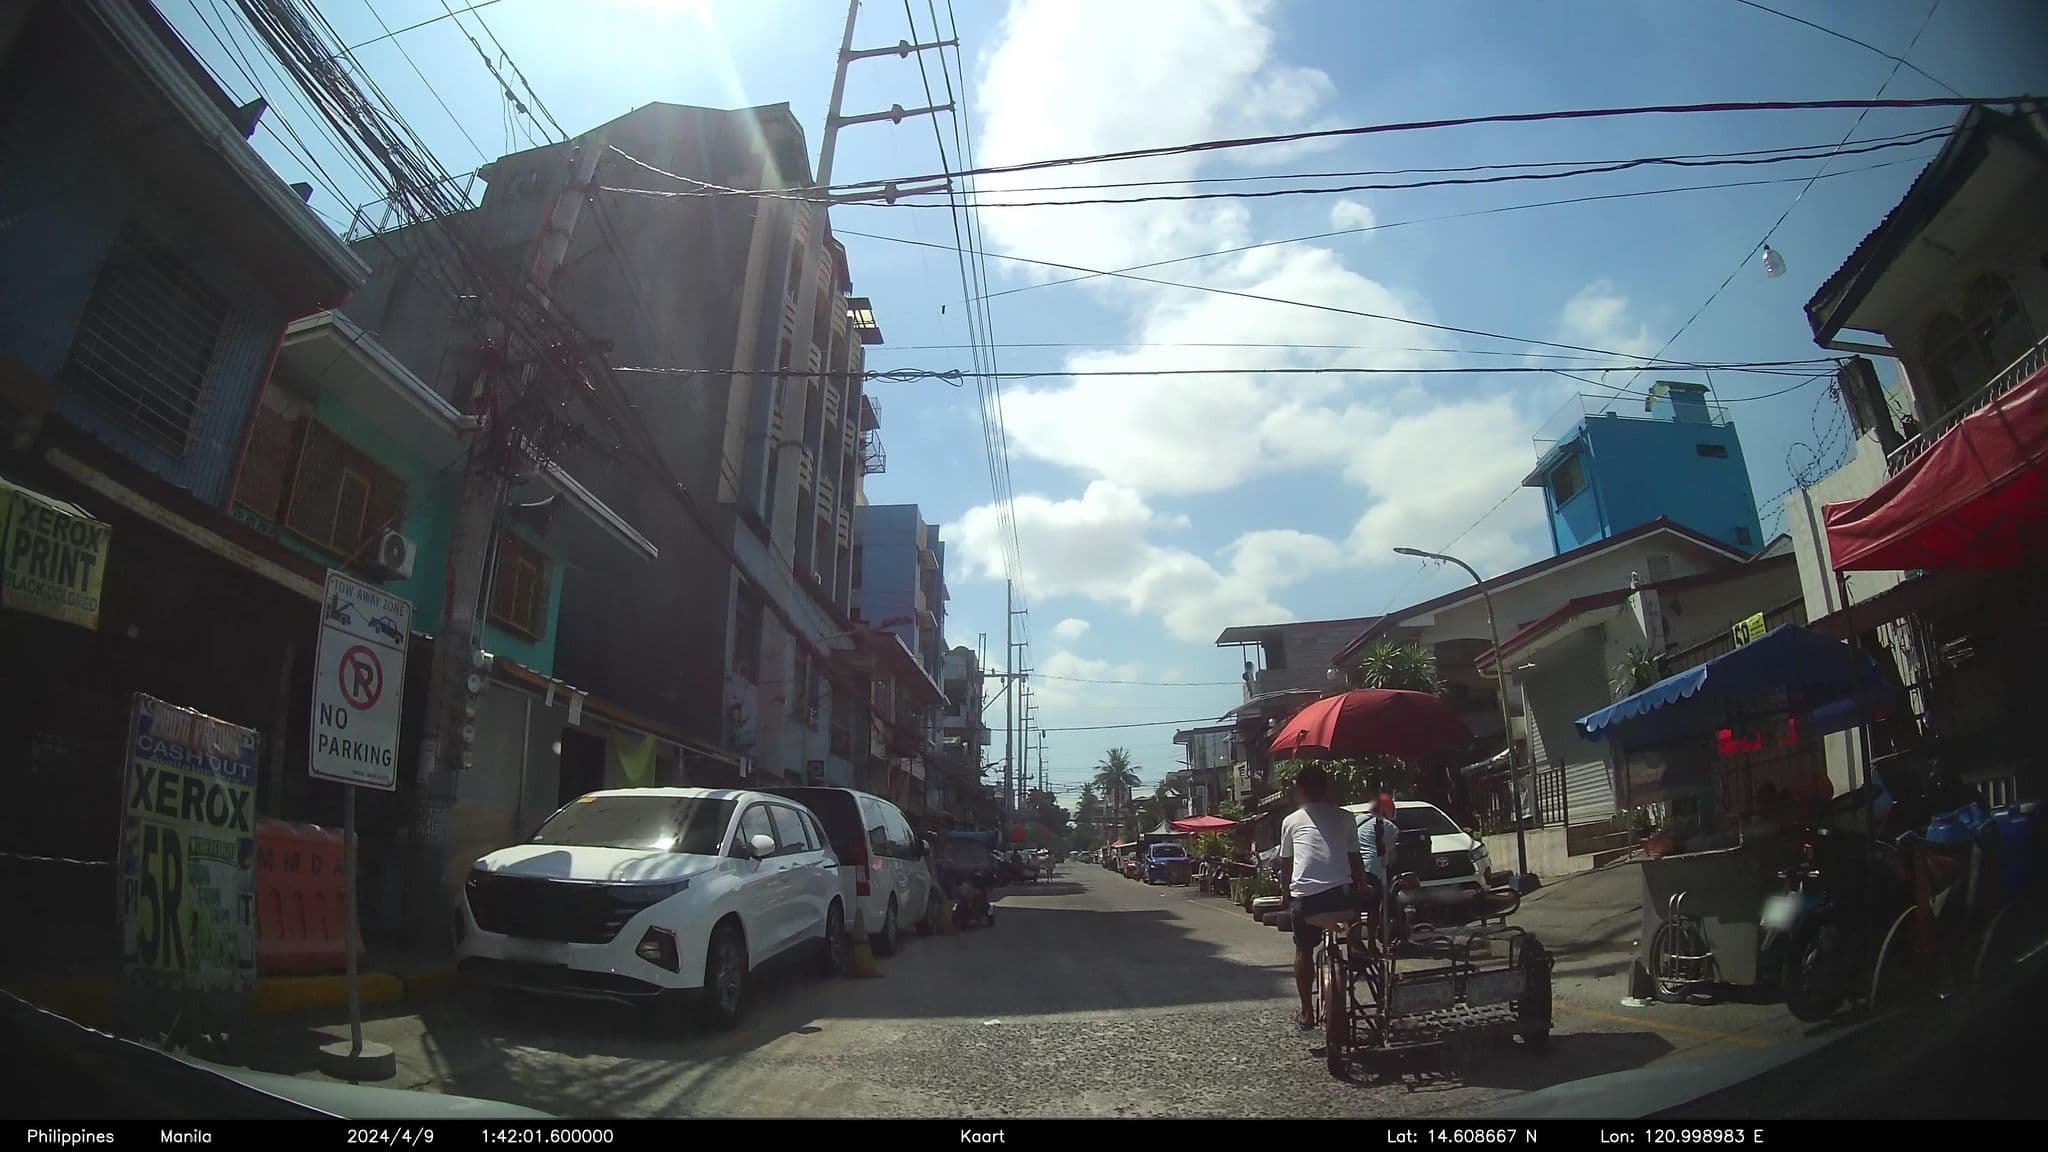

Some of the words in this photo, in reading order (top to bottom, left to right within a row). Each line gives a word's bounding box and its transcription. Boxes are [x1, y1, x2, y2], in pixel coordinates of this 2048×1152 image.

[17, 498, 101, 552] XEROX
[10, 527, 97, 592] PRINT
[335, 579, 354, 597] TOW
[356, 590, 381, 608] AWAY
[383, 599, 404, 617] ZONE
[320, 702, 348, 730] NO
[138, 735, 203, 767] CASH
[209, 755, 252, 778] OUT
[318, 733, 392, 767] PARKING
[130, 763, 251, 833] XEROX
[137, 823, 188, 970] 5R
